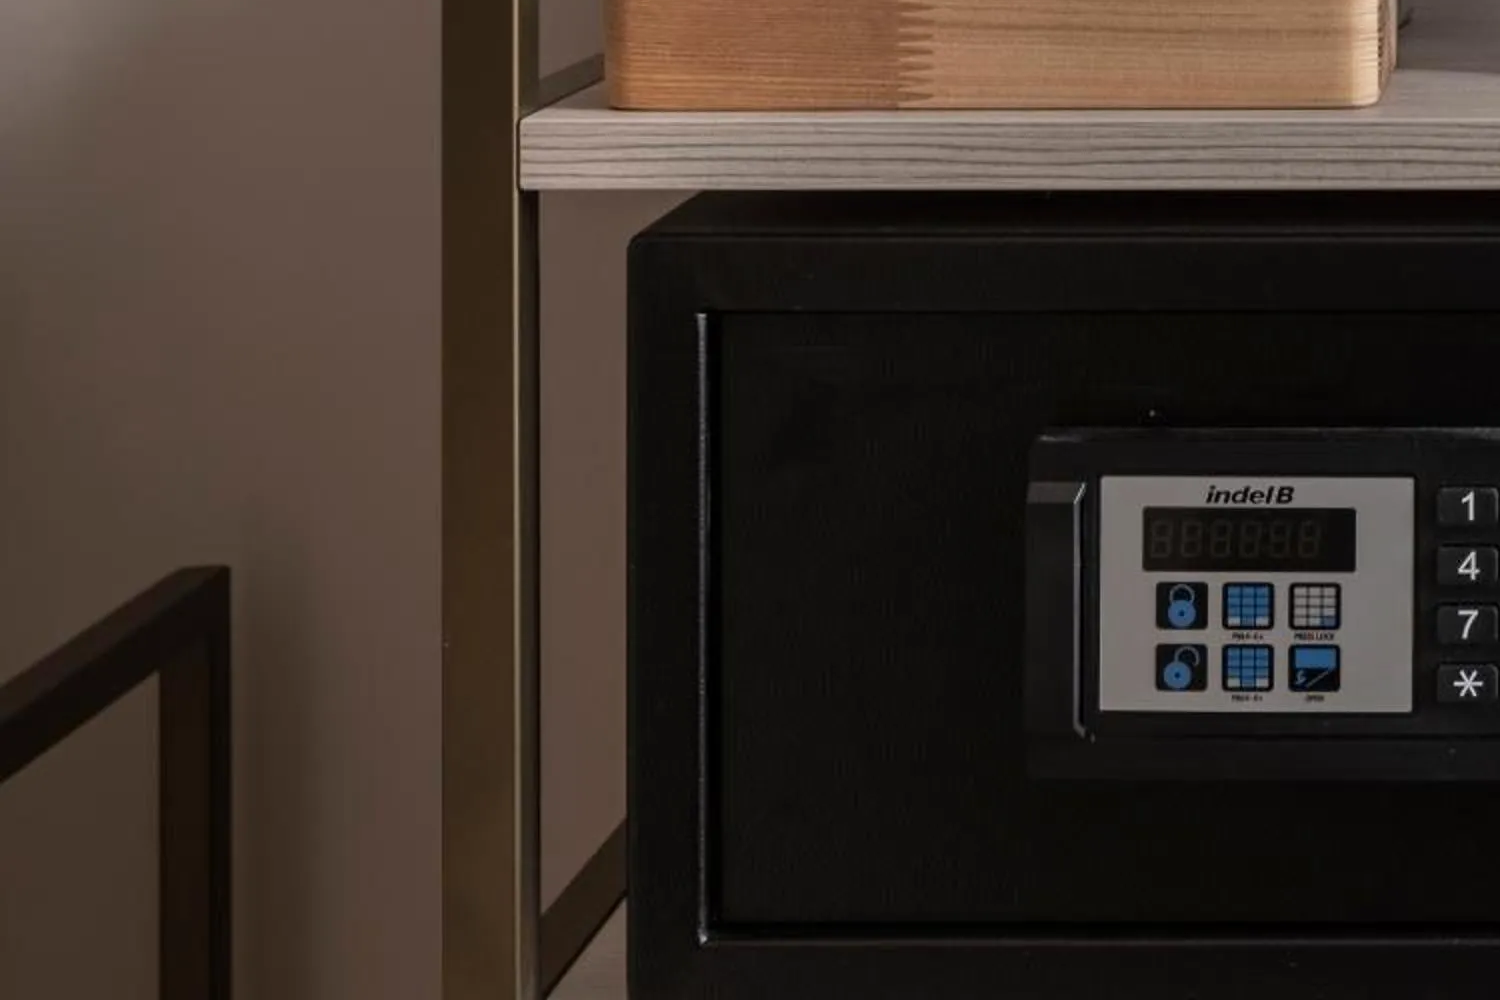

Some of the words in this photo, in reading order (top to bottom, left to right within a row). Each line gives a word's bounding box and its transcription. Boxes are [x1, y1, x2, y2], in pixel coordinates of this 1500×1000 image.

[1461, 490, 1475, 521] 1
[1457, 551, 1480, 581] 4
[1457, 609, 1478, 640] 7
